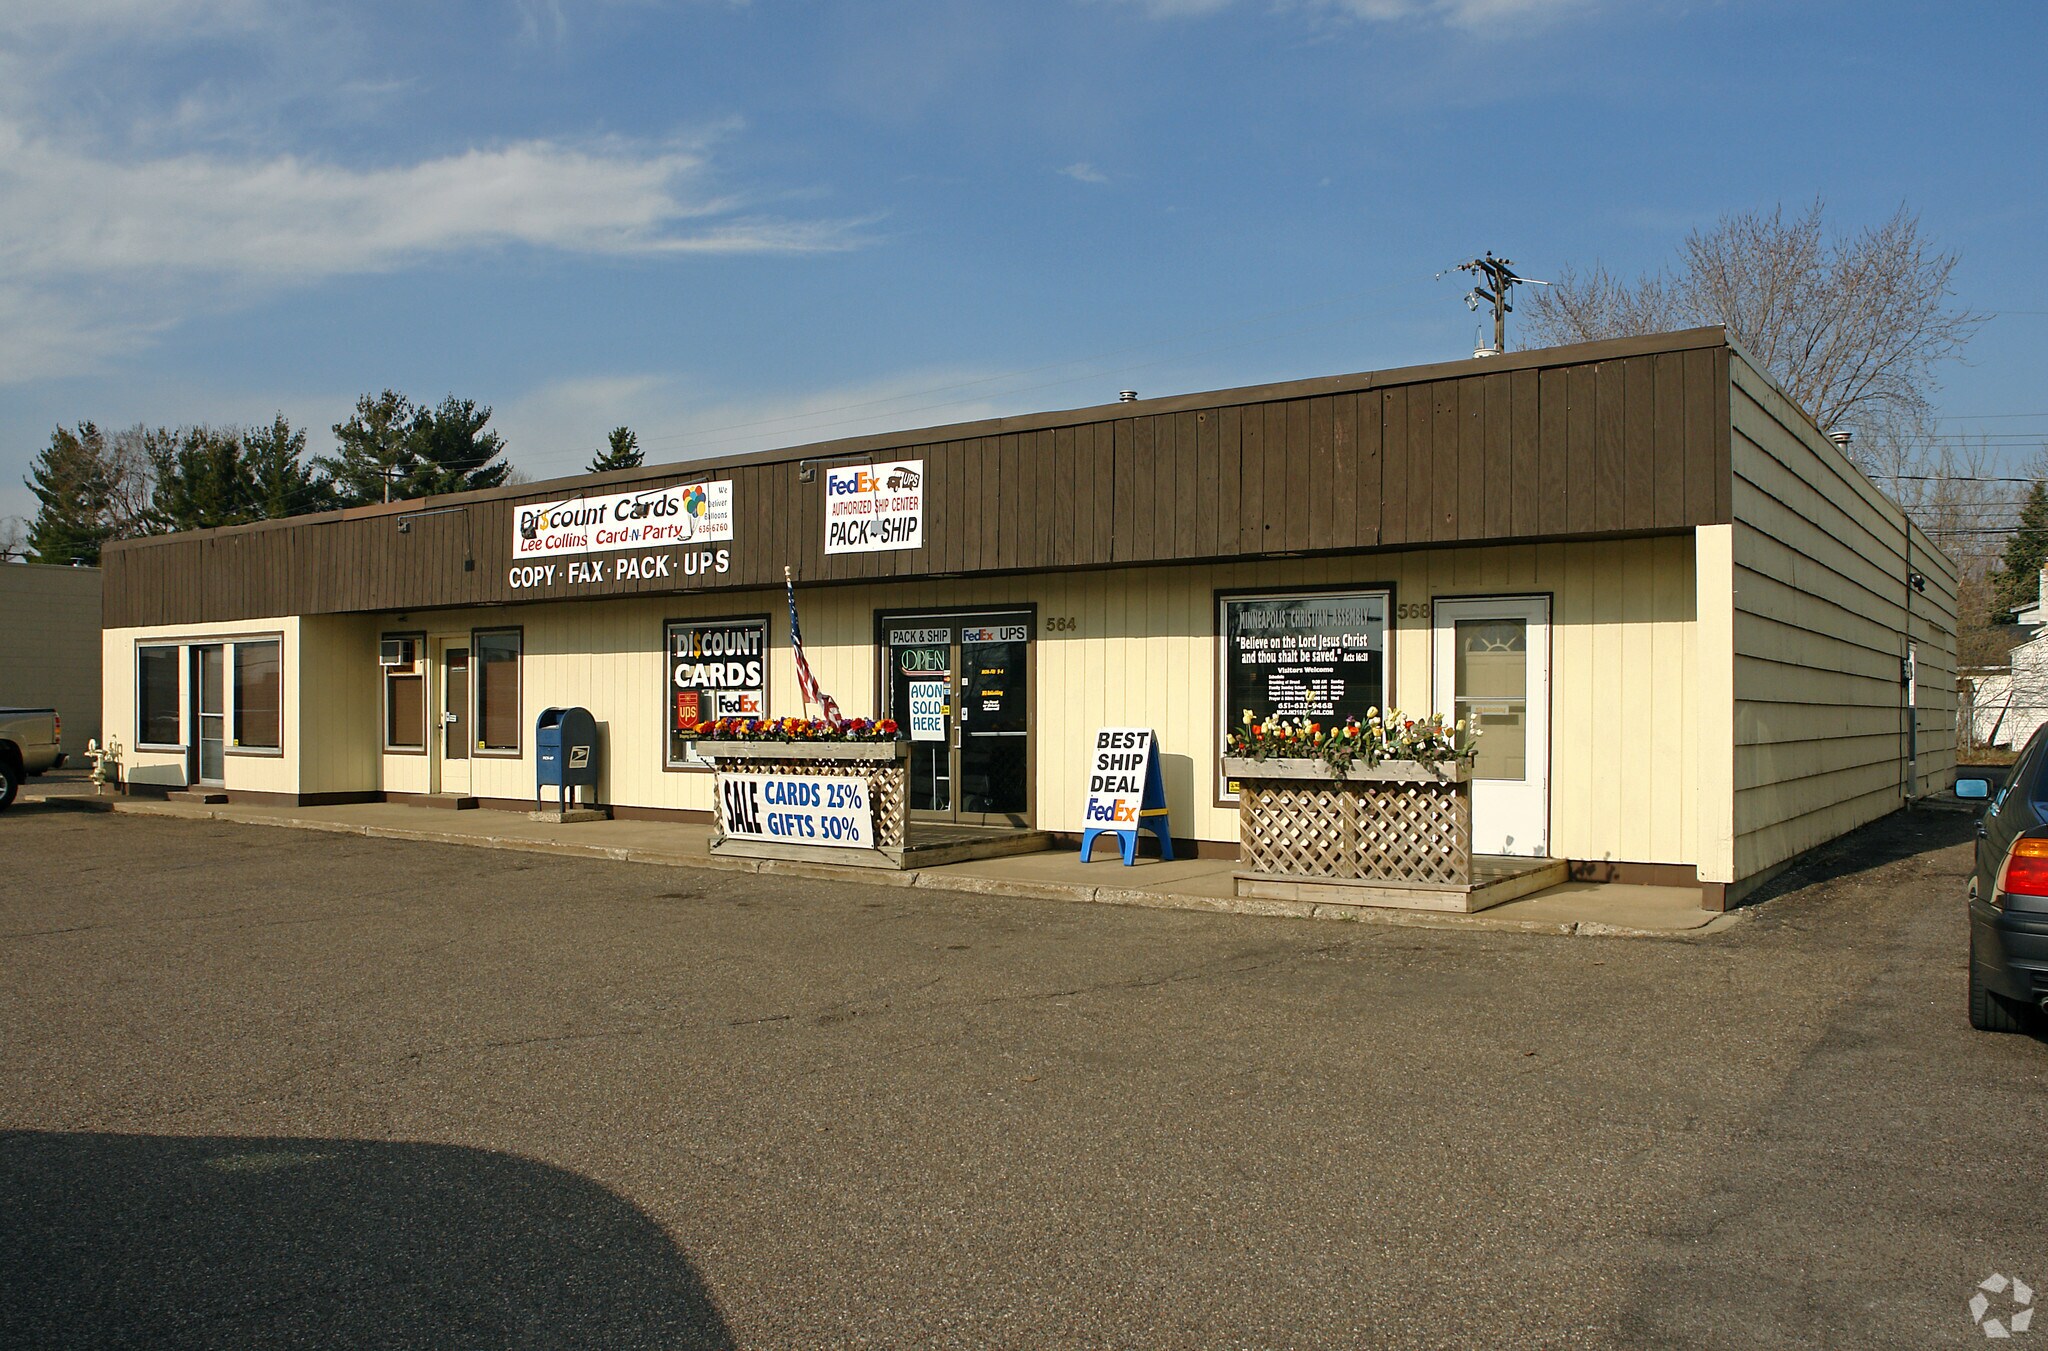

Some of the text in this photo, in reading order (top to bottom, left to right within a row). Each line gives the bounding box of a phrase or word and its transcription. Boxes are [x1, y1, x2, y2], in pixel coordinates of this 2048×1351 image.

[718, 486, 728, 494] We
[829, 472, 919, 496] FedEx UPS
[614, 494, 679, 521] Cards
[832, 496, 918, 516] AUTHORIZED SHIP CENTER
[520, 538, 542, 552] Lee
[546, 533, 587, 550] Collins
[509, 550, 730, 589] COPY FAX PACK UPS
[1239, 608, 1369, 629] MINNEAPOLIS CHRISTIAN ASSEMBLY
[1398, 604, 1430, 619] 568
[1046, 617, 1076, 632] 564
[893, 630, 948, 643] PACK & SHIP
[964, 627, 1025, 642] FedEx UPS
[1270, 638, 1280, 648] on
[1282, 636, 1296, 648] the
[1299, 635, 1316, 647] Lord
[1319, 634, 1340, 650] Jesus
[1342, 633, 1368, 647] Christ
[902, 650, 944, 671] OPEN
[1242, 651, 1256, 663] and
[1258, 651, 1276, 663] thou
[1278, 650, 1298, 662] shalt
[1300, 650, 1310, 662] be
[1343, 653, 1354, 662] Acts
[675, 661, 761, 687] CARDS
[911, 684, 942, 698] AVON
[719, 695, 759, 713] FedEx
[912, 701, 941, 715] SOLD
[680, 706, 696, 722] ups
[913, 717, 941, 730] HERE
[1097, 732, 1149, 748] BEST
[1097, 754, 1143, 770] SHIP
[1090, 776, 1140, 792] DEAL
[765, 781, 862, 809] CARDS 25%
[724, 779, 763, 833] SALE
[1087, 798, 1137, 822] FedEx
[768, 812, 859, 842] GIFTS 50%
